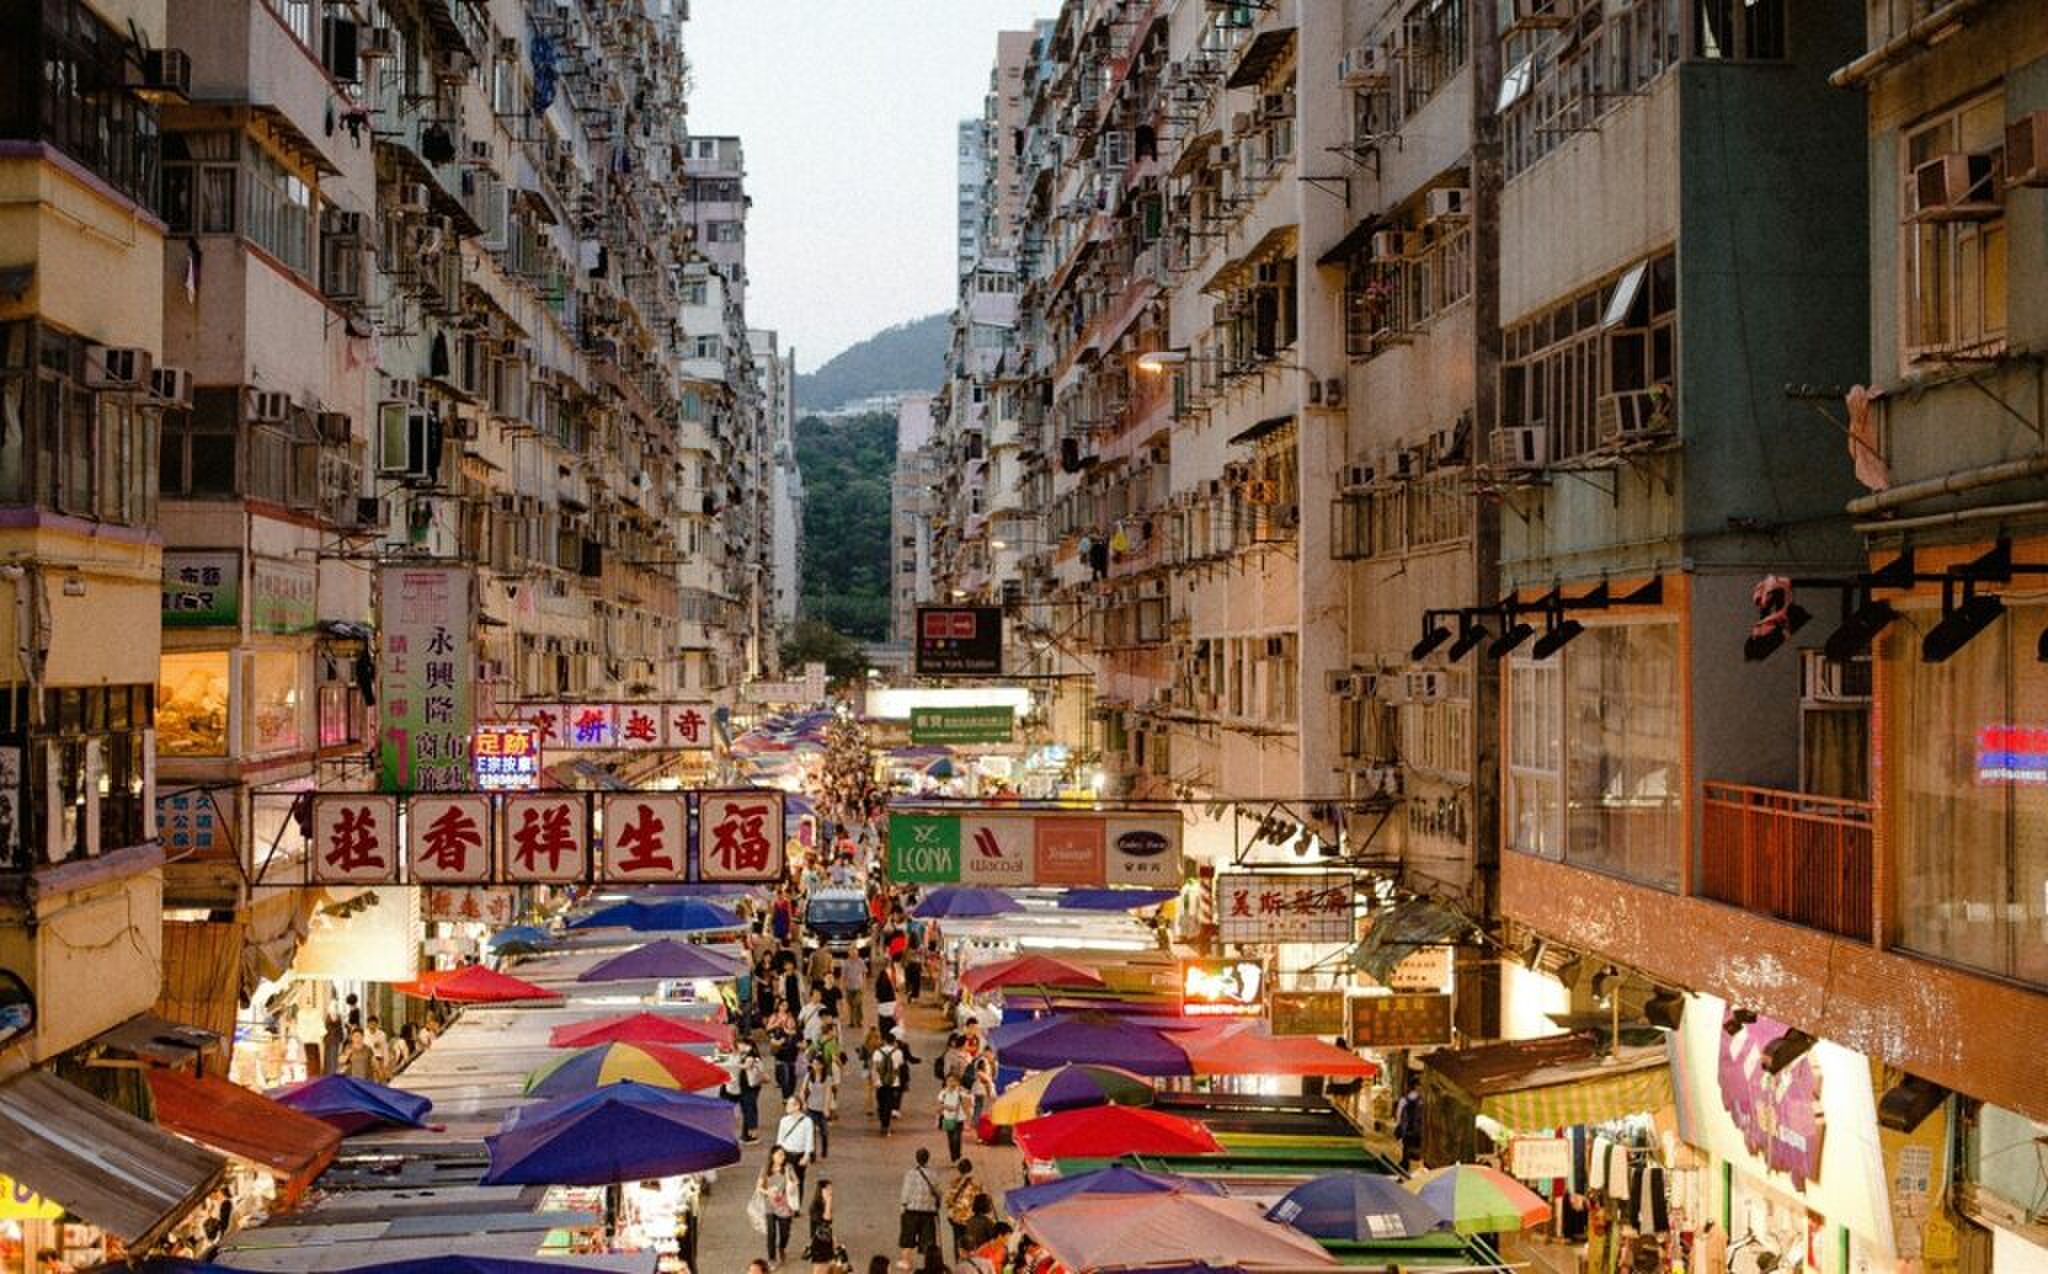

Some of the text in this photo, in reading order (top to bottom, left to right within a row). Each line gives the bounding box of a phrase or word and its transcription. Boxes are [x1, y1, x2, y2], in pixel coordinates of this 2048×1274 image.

[427, 626, 455, 724] 永興隆
[970, 859, 1024, 873] Wacoal
